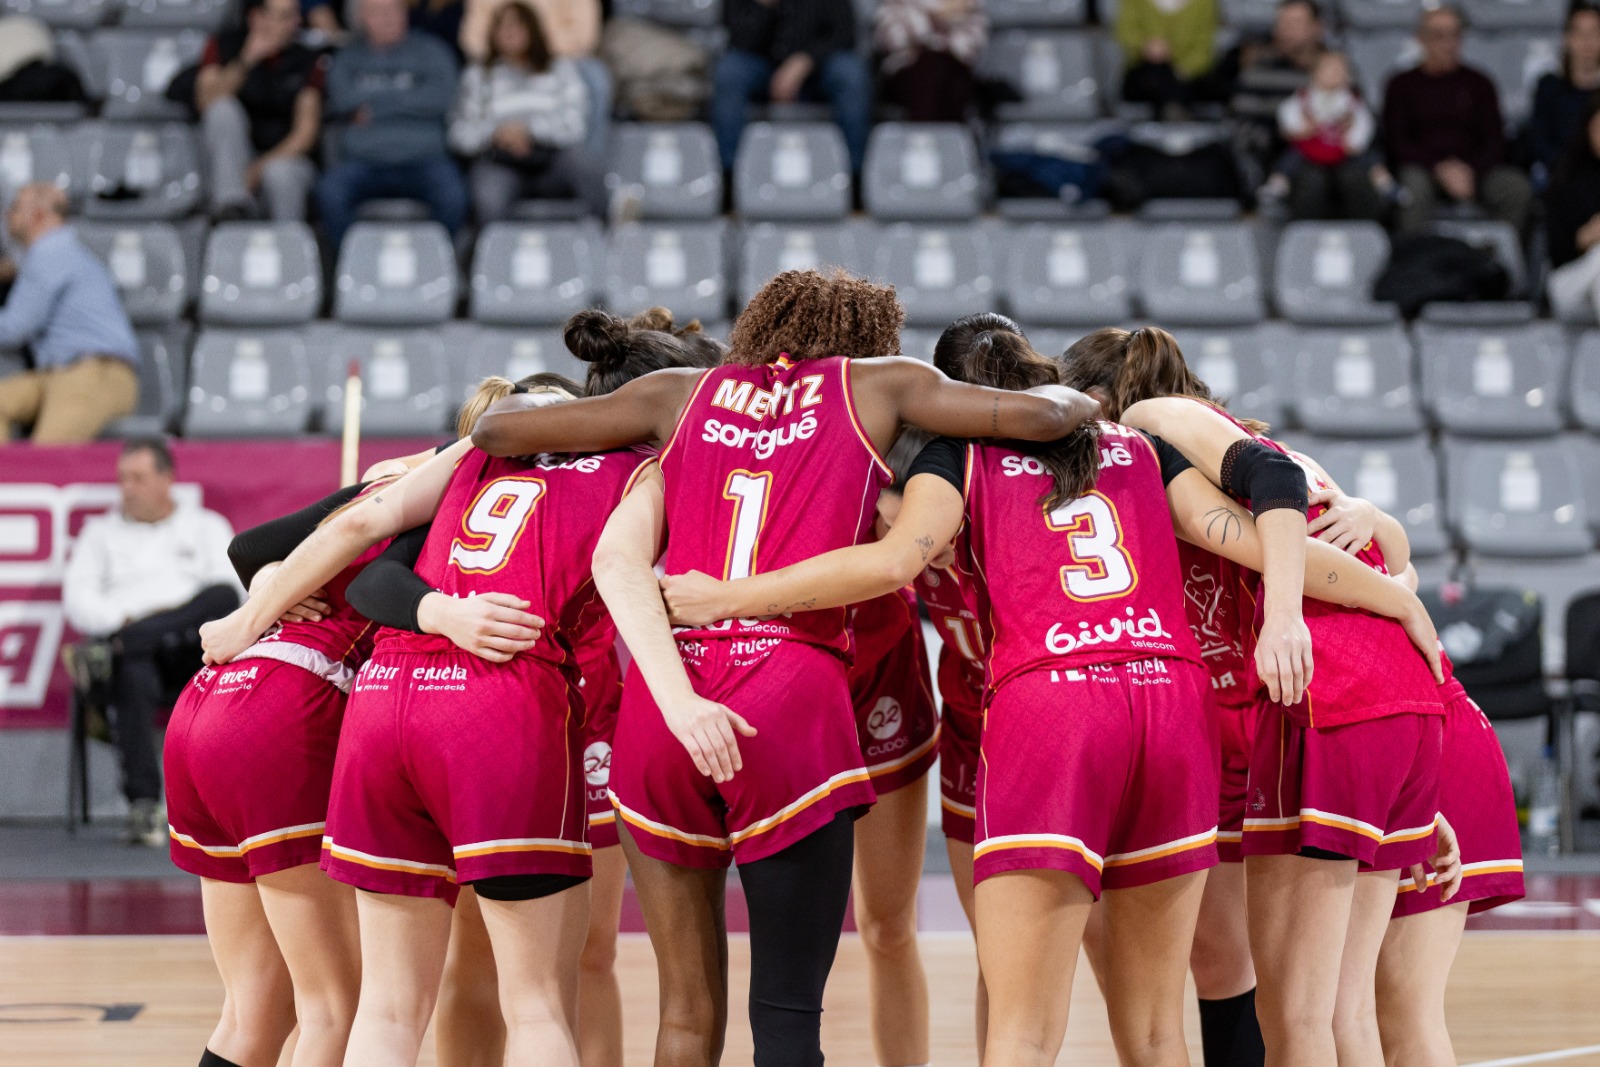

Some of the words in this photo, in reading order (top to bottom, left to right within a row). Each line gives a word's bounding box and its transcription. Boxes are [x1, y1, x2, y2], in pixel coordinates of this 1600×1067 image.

[711, 374, 824, 422] MERTZ
[448, 476, 547, 576] 9
[722, 468, 773, 582] 1
[1043, 489, 1139, 603] 3
[1130, 639, 1176, 652] telecom
